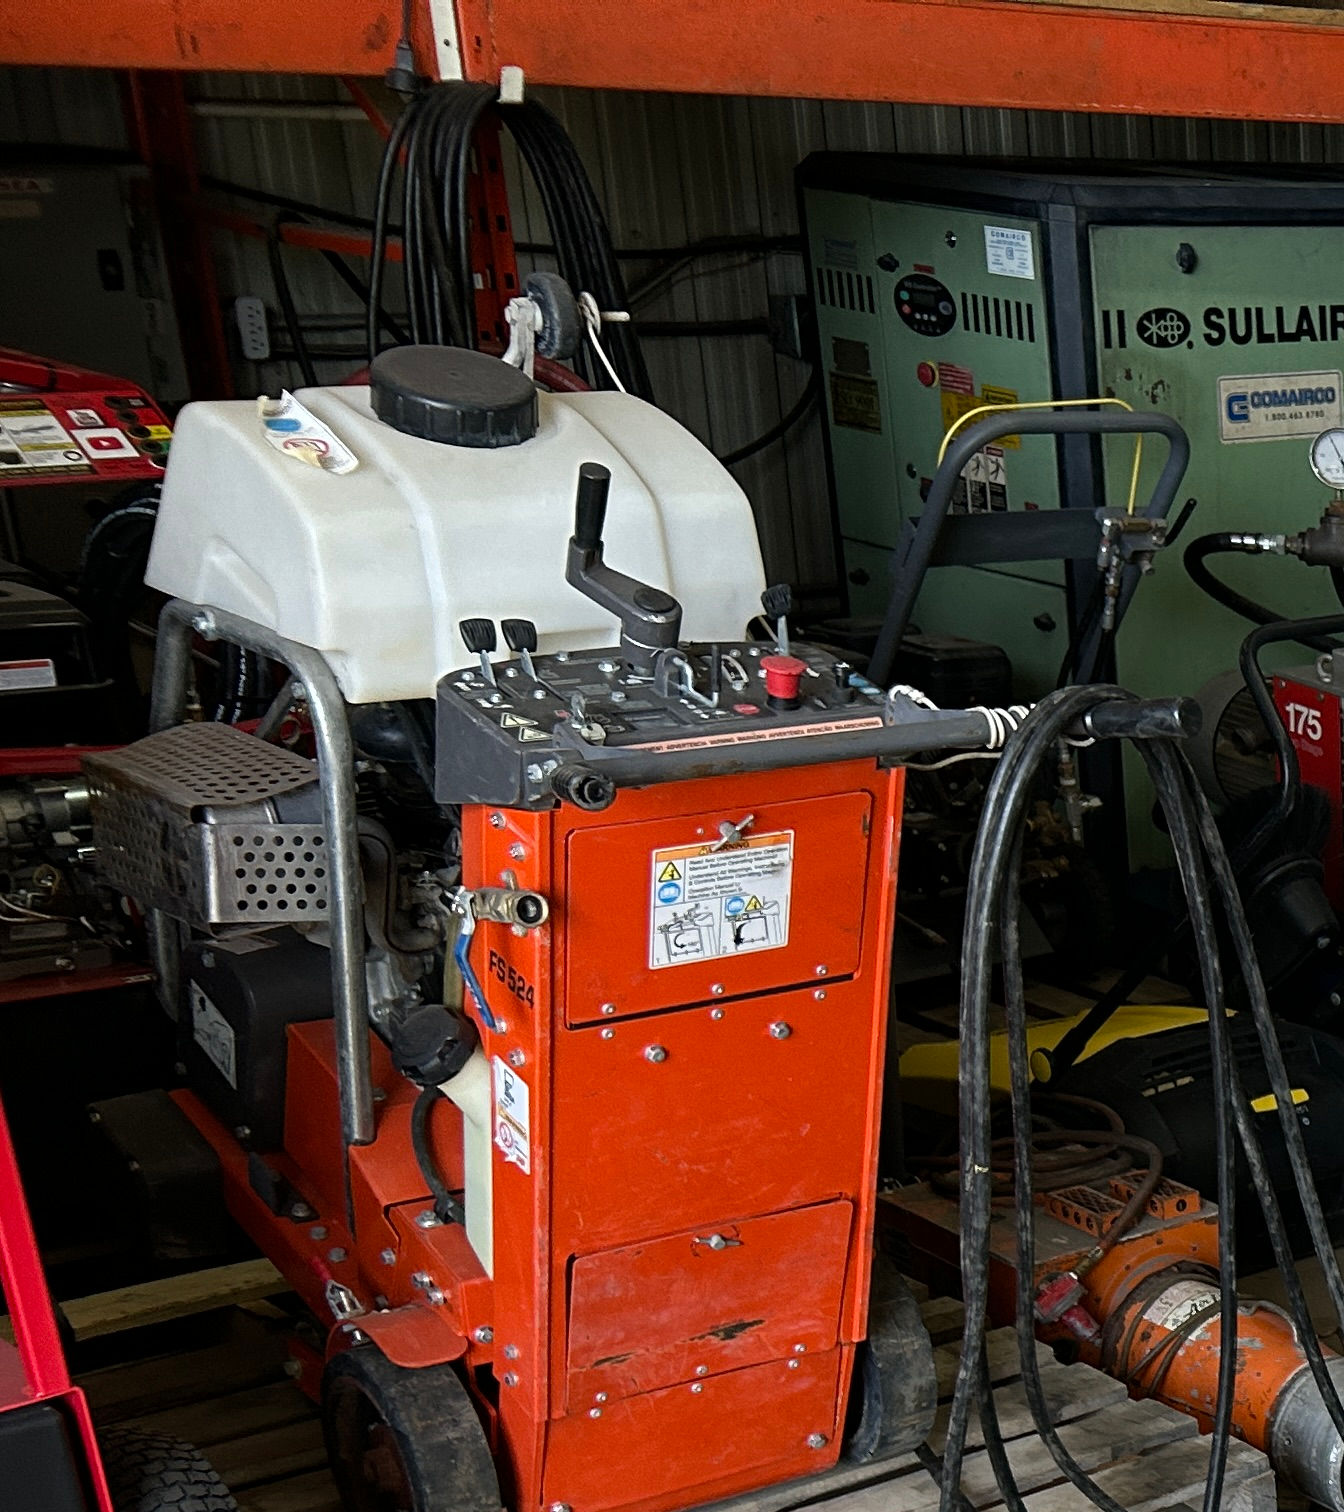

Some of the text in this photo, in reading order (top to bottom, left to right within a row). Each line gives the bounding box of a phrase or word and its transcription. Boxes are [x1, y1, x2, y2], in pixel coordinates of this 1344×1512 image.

[1250, 386, 1336, 409] COMAIRCO
[1285, 703, 1323, 741] 175
[489, 950, 506, 984] FS
[506, 967, 536, 1010] 524
